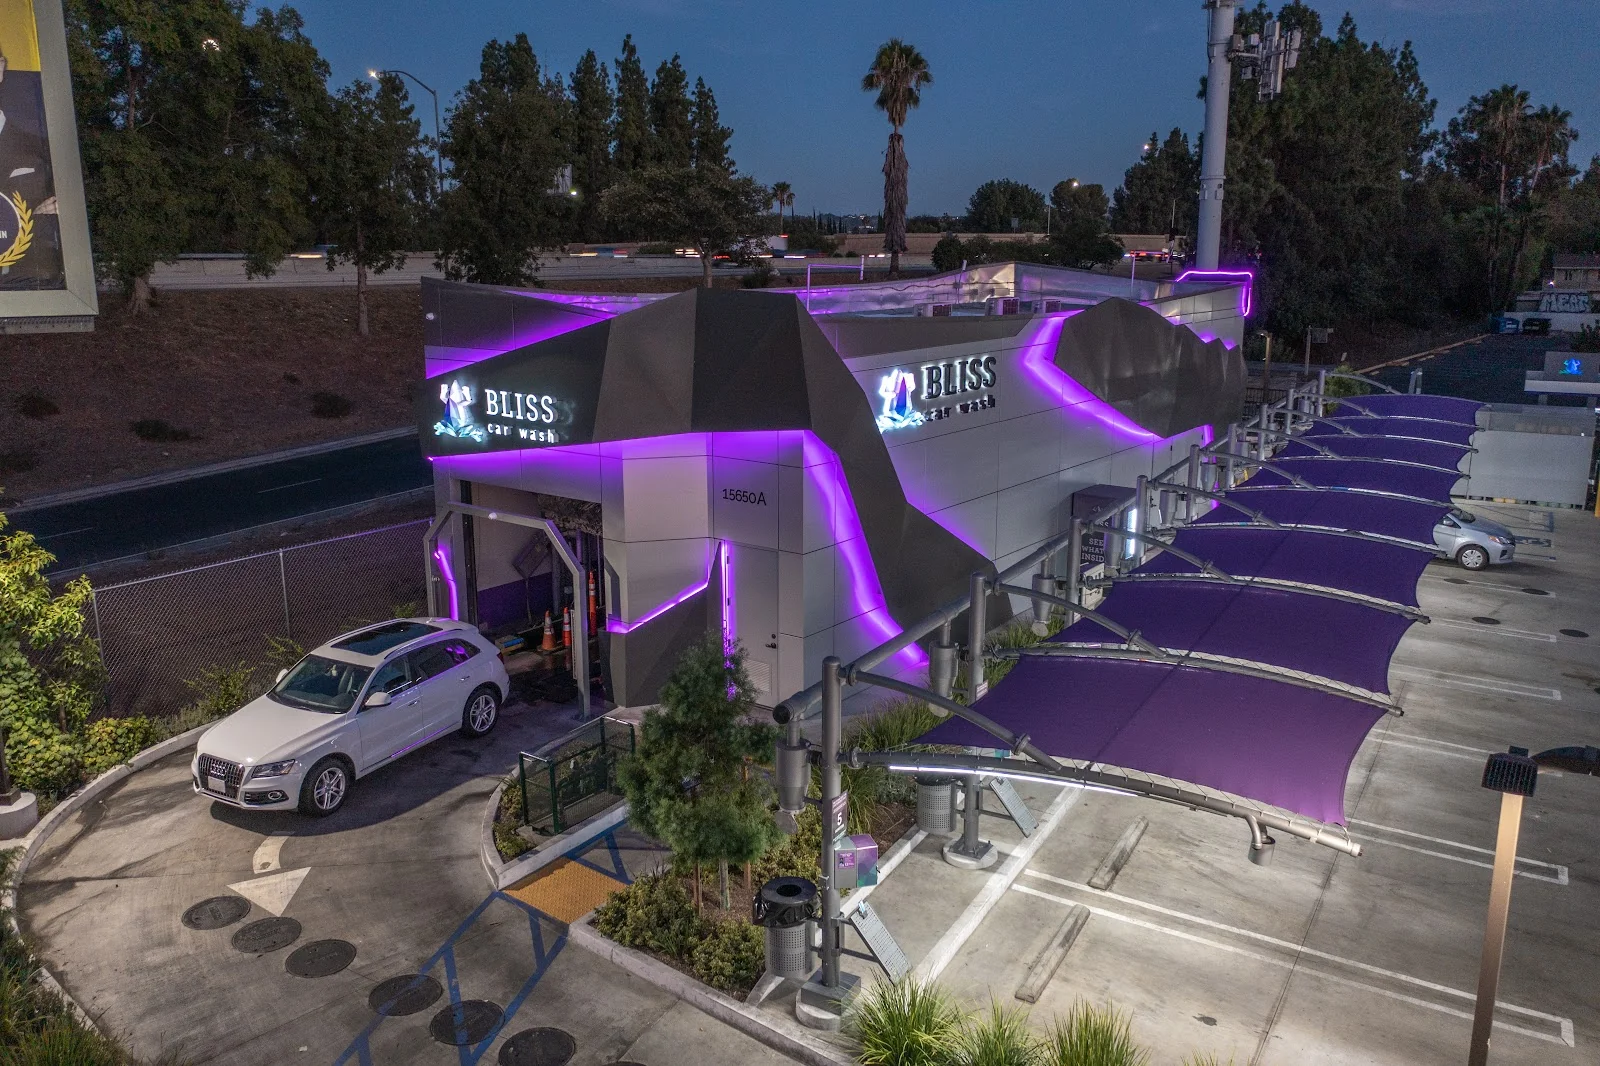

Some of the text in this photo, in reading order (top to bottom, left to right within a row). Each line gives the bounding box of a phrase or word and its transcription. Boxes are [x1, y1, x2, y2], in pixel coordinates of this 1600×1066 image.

[923, 355, 997, 400] BLISS
[484, 388, 556, 423] BLISS
[925, 394, 996, 422] car wash
[487, 422, 556, 444] car wash
[722, 488, 767, 506] 15650A
[1088, 538, 1104, 547] SEE
[1081, 552, 1105, 562] INSID
[836, 812, 843, 827] 5
